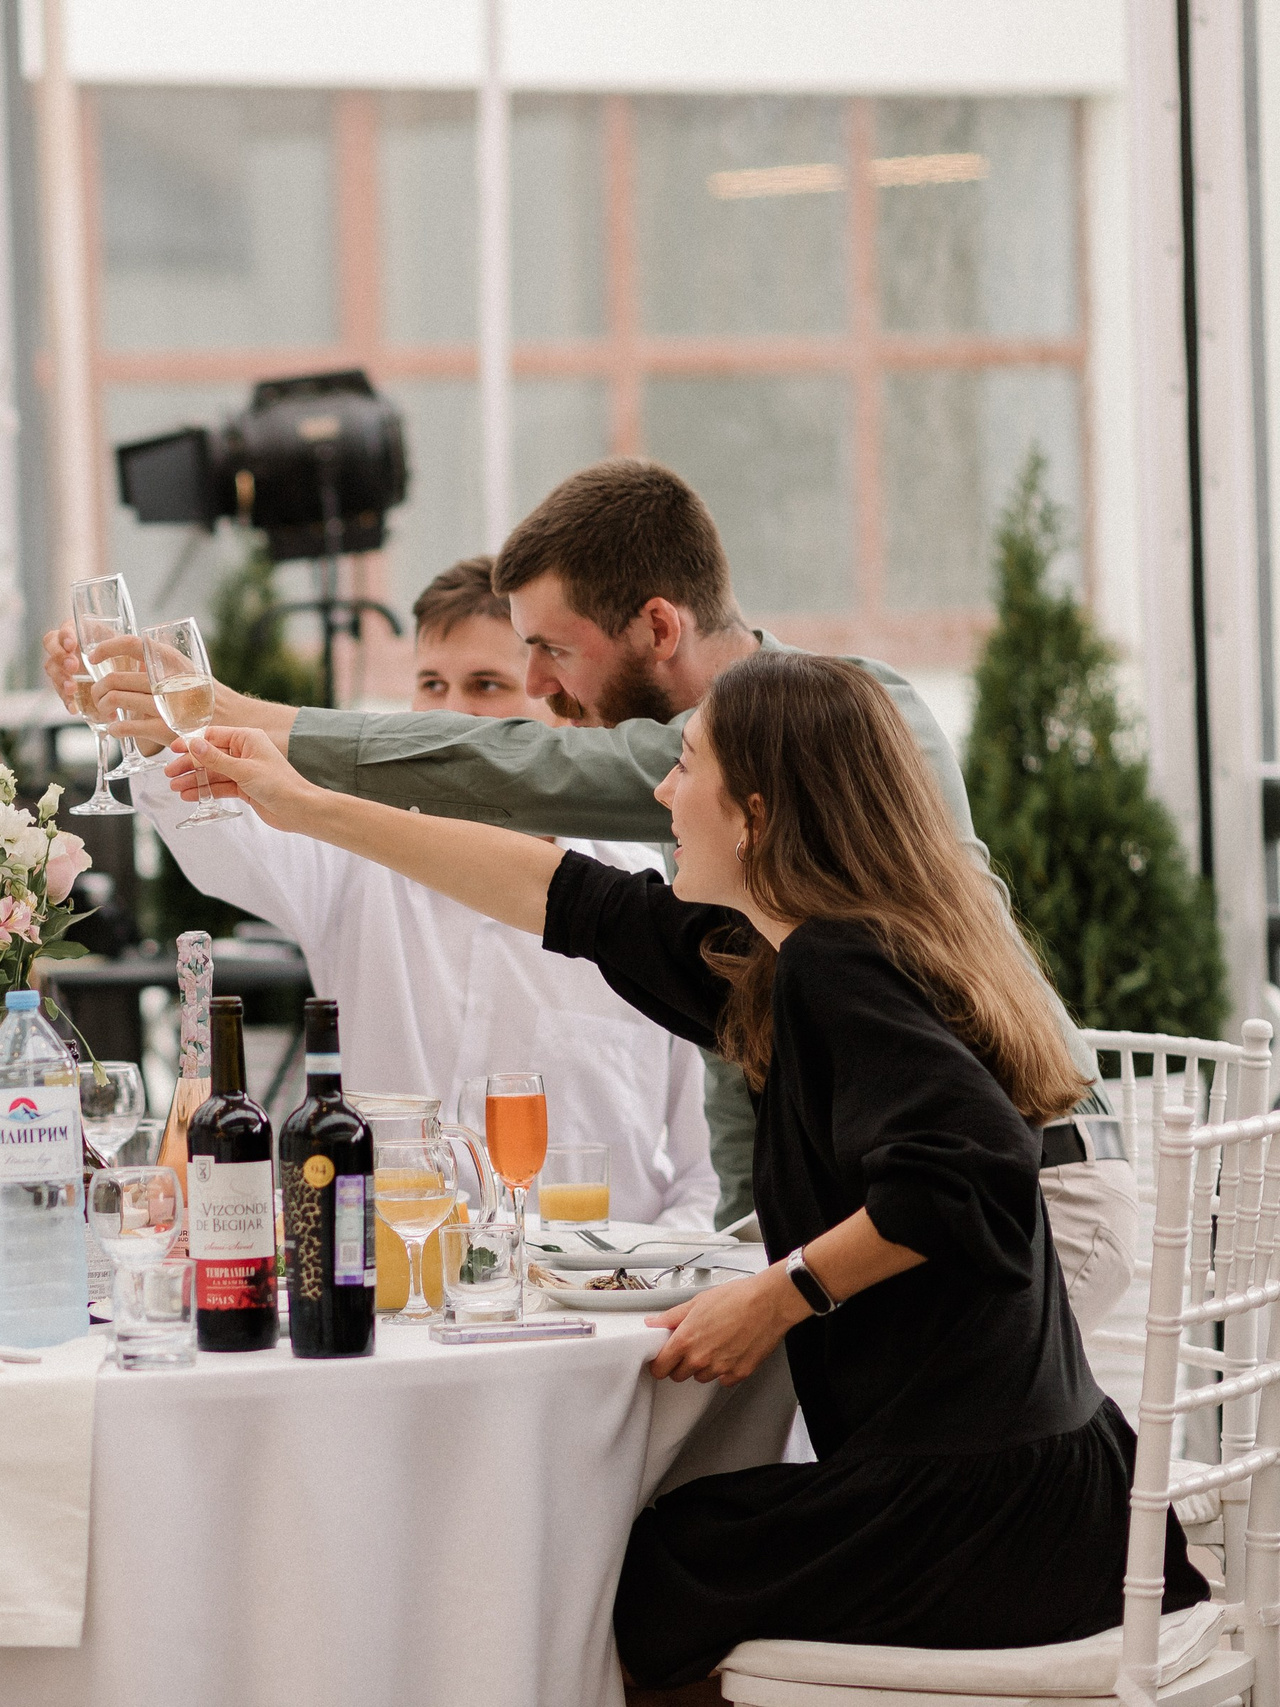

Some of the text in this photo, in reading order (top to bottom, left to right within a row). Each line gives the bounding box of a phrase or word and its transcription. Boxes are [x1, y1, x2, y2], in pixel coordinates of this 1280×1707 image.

[202, 1203, 268, 1216] VIZCONDE
[196, 1218, 264, 1233] DE BEGIJAR
[206, 1267, 255, 1278] TEMPRANILLO
[207, 1296, 235, 1305] SPAIN
